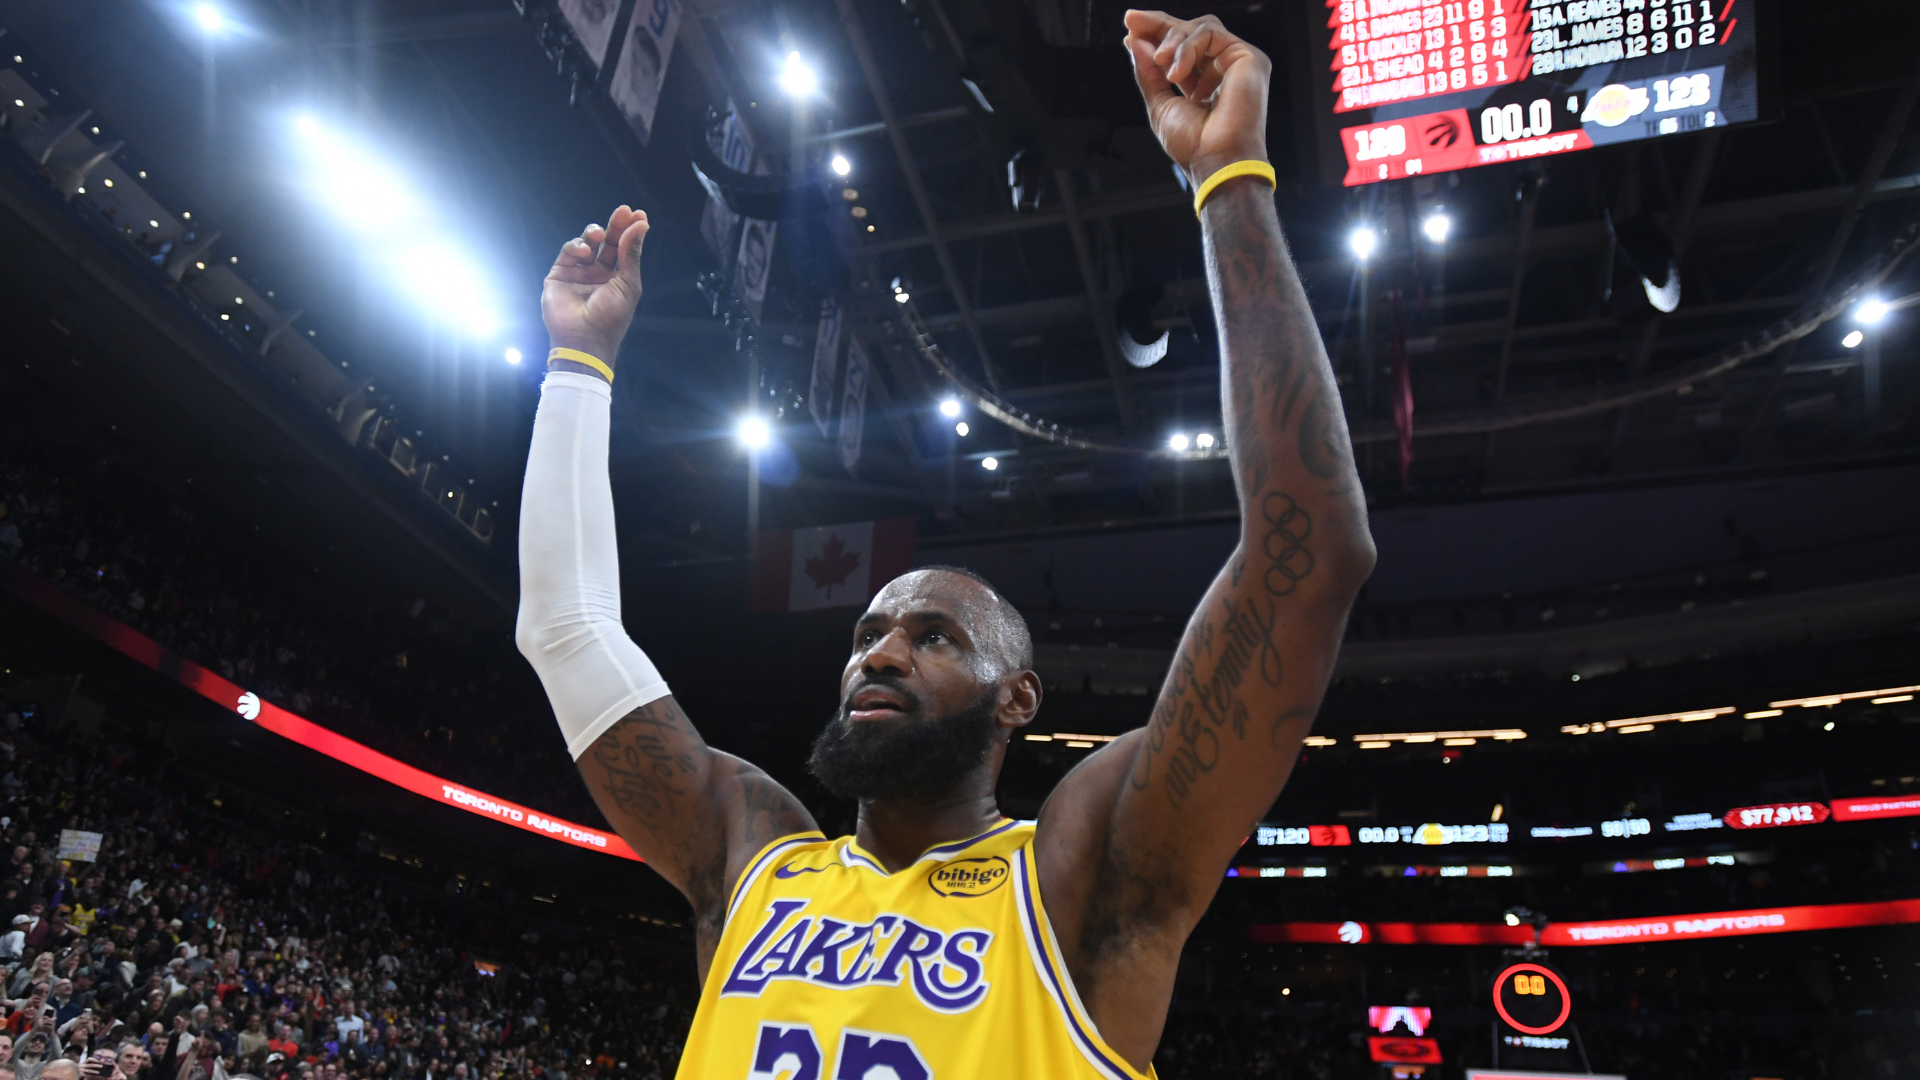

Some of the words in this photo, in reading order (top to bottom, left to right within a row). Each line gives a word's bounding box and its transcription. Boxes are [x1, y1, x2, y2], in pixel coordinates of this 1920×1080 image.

[1340, 23, 1355, 43] 4
[1370, 10, 1422, 39] BARNES
[1422, 6, 1444, 28] 23
[1445, 2, 1465, 25] 11
[1468, 0, 1484, 20] 9
[1341, 44, 1358, 65] 5
[1424, 28, 1445, 50] 13
[1451, 24, 1463, 46] 1
[1469, 20, 1485, 42] 5
[1490, 16, 1507, 38] 3
[1531, 7, 1553, 31] 15
[1531, 29, 1554, 53] 23
[1569, 16, 1623, 46] JAMES
[1626, 13, 1644, 35] 8
[1650, 9, 1668, 31] 6
[1672, 5, 1694, 27] 11
[1700, 0, 1713, 22] 1
[1341, 65, 1361, 88] 23
[1373, 54, 1424, 82] SHEAD
[1428, 50, 1444, 70] 4
[1450, 46, 1465, 68] 2
[1471, 42, 1487, 64] 6
[1492, 38, 1508, 59] 4
[1532, 52, 1554, 75] 28
[1625, 35, 1648, 59] 12
[1651, 31, 1668, 54] 3
[1675, 27, 1692, 50] 0
[1698, 23, 1716, 45] 2
[1427, 71, 1448, 94] 13
[1451, 67, 1467, 90] 8
[1472, 63, 1488, 86] 5
[1495, 61, 1508, 82] 1
[1481, 98, 1552, 144] 00.0
[1704, 111, 1716, 128] 2
[443, 785, 523, 823] TORONTO
[527, 813, 607, 848] RAPTORS
[1276, 827, 1310, 845] 120
[1358, 827, 1399, 843] 00.0
[937, 868, 1005, 885] bibigo
[1568, 922, 1669, 941] TORONTO
[1674, 914, 1785, 934] RAPTORS
[719, 897, 993, 1015] LAKERS
